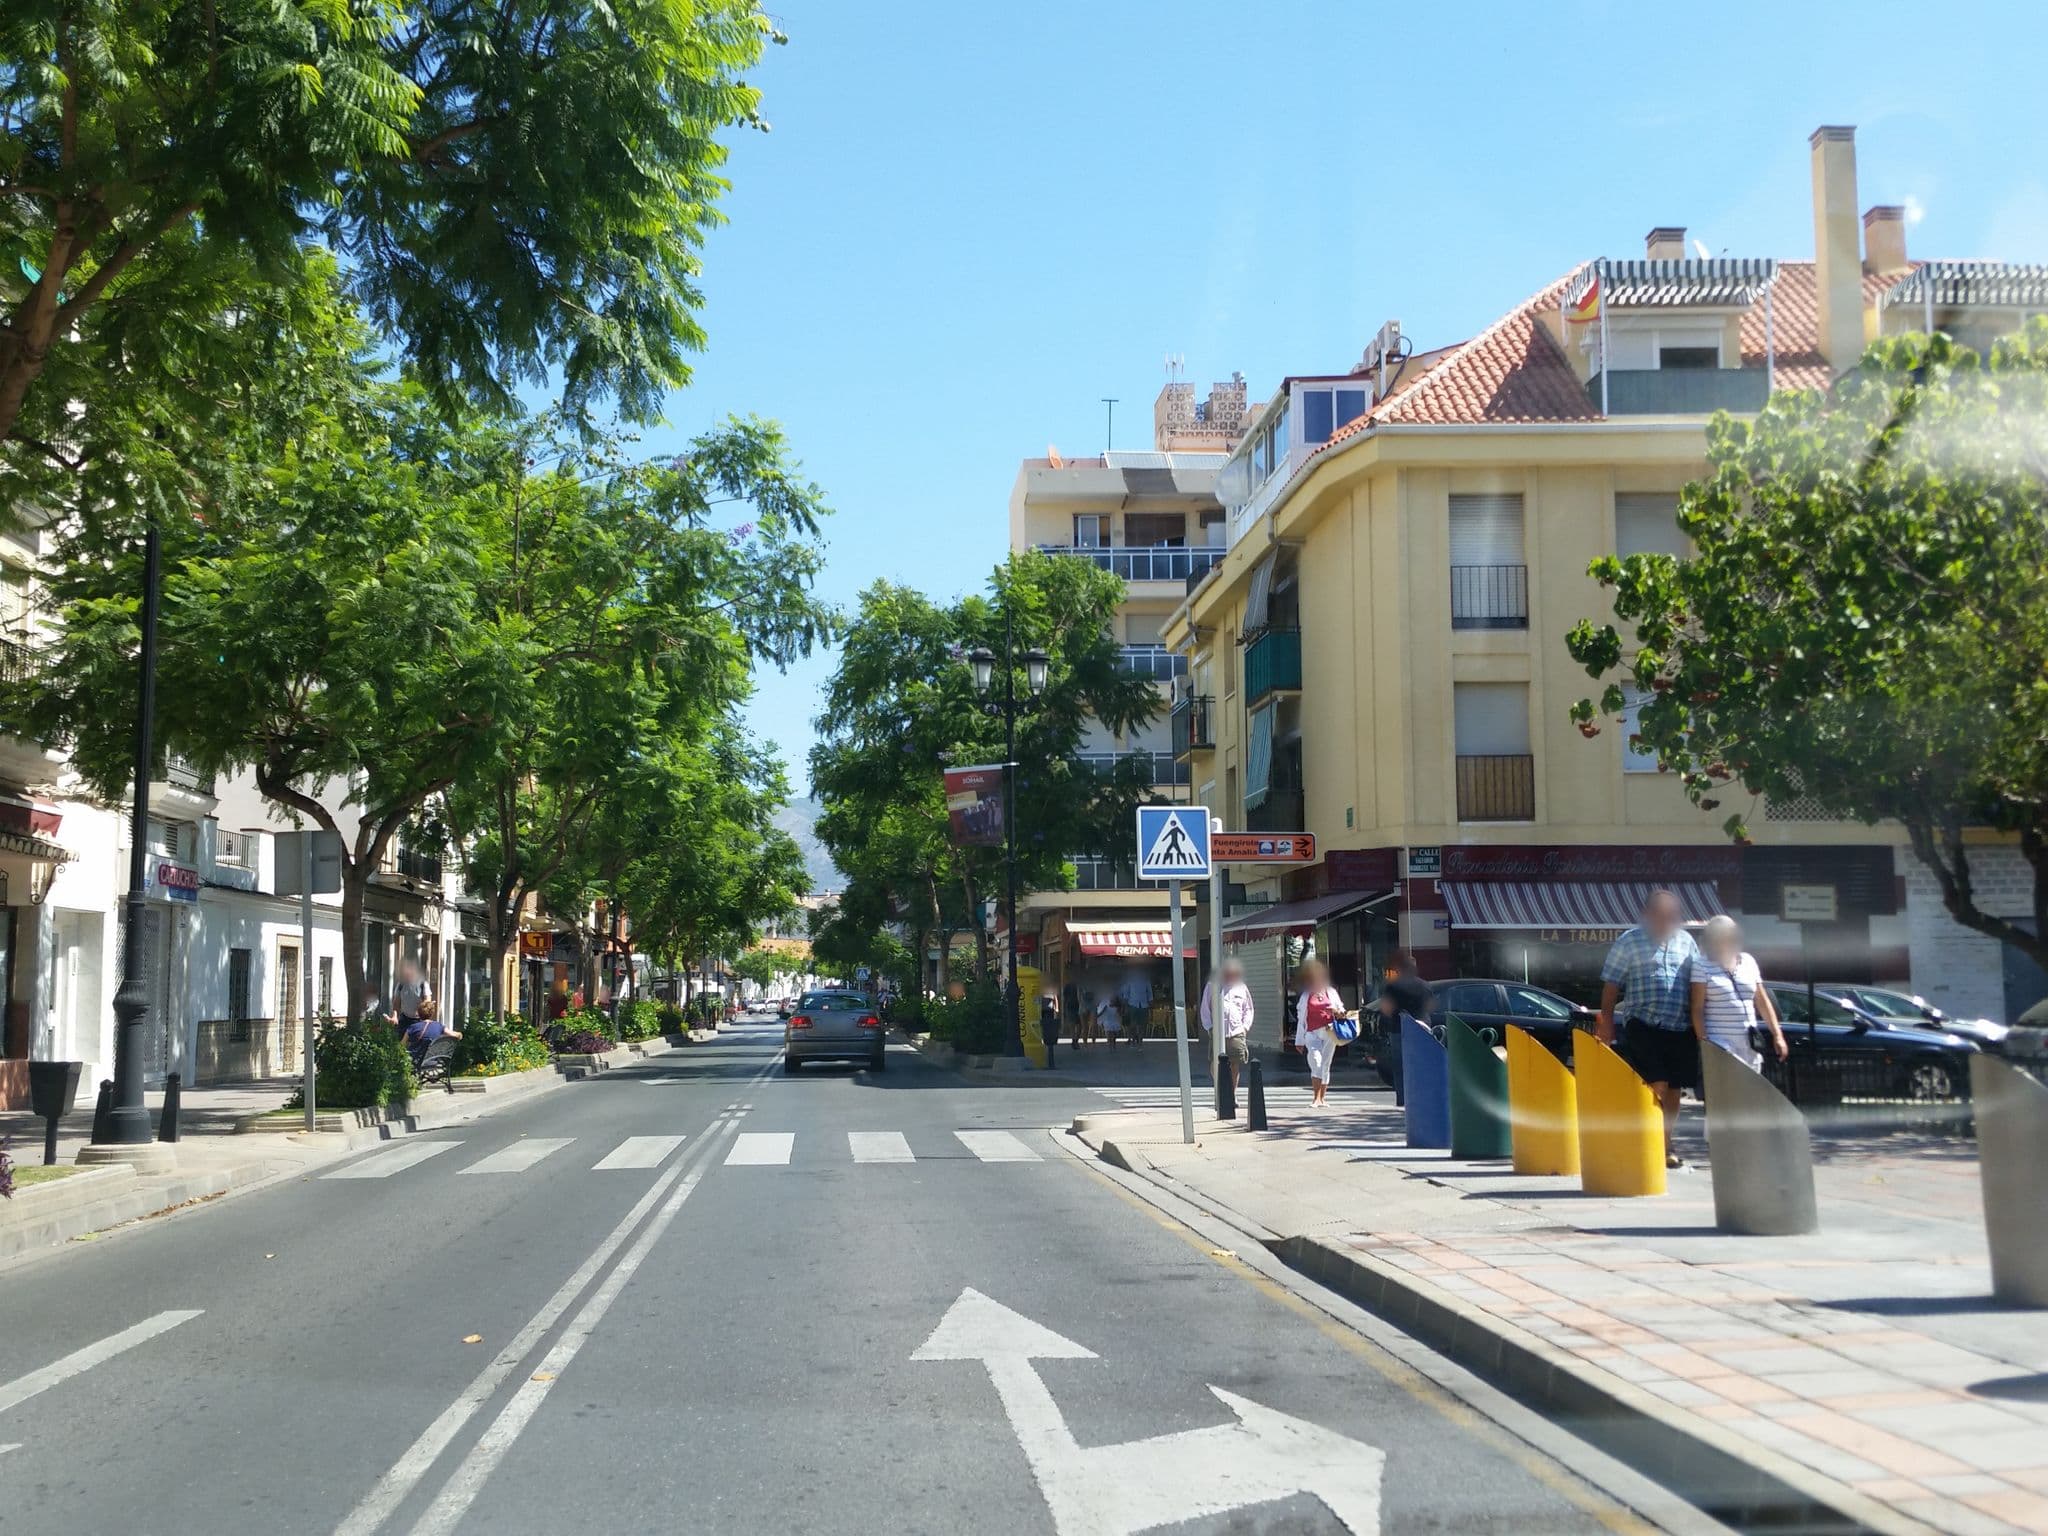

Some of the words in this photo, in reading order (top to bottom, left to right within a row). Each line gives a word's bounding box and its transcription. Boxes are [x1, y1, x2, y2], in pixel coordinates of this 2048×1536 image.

[1214, 839, 1259, 847] Fuengirola
[1541, 929, 1559, 941] LA
[1569, 929, 1624, 941] TRADIC
[1116, 946, 1149, 955] REINA
[1154, 946, 1174, 955] AN
